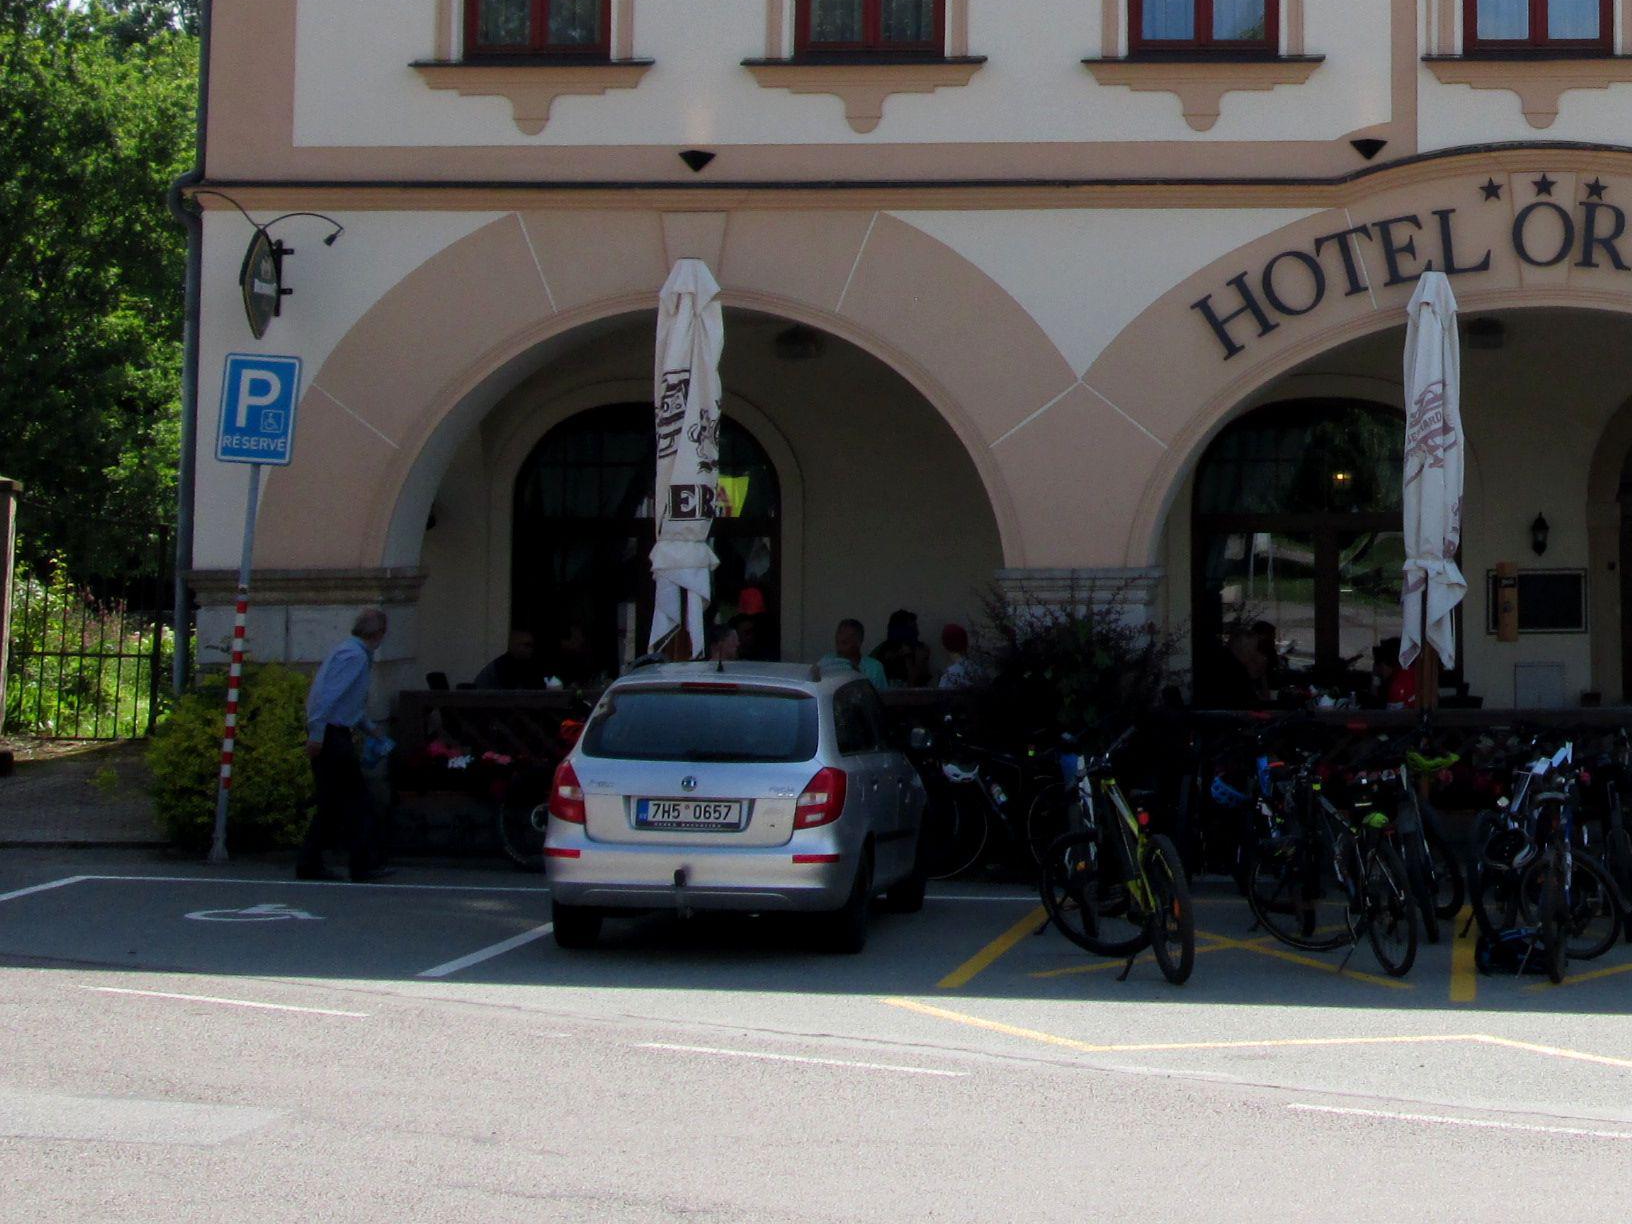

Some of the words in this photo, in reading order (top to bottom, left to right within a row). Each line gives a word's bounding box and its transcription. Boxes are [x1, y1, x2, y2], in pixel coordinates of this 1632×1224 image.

[1190, 208, 1491, 361] HOTEL
[235, 368, 282, 428] P
[222, 432, 286, 451] RÉSERVÉ
[652, 803, 680, 819] 7H5
[693, 804, 731, 820] 0657
